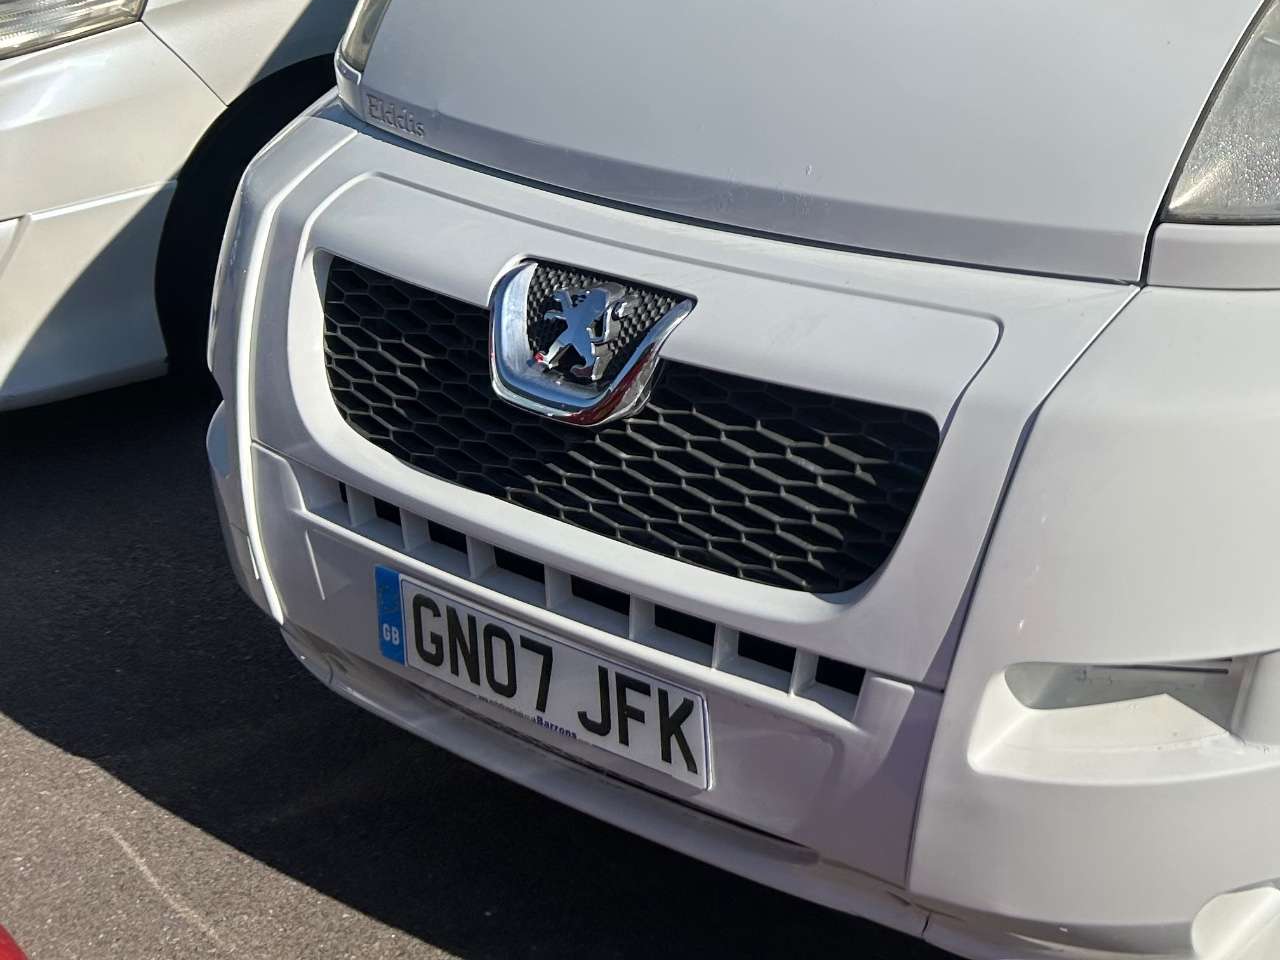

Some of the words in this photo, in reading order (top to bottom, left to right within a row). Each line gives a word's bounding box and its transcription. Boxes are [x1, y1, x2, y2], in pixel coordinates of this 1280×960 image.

[366, 94, 425, 138] Elddis
[383, 623, 400, 645] GB
[412, 593, 554, 713] GN07
[577, 665, 698, 775] JFK
